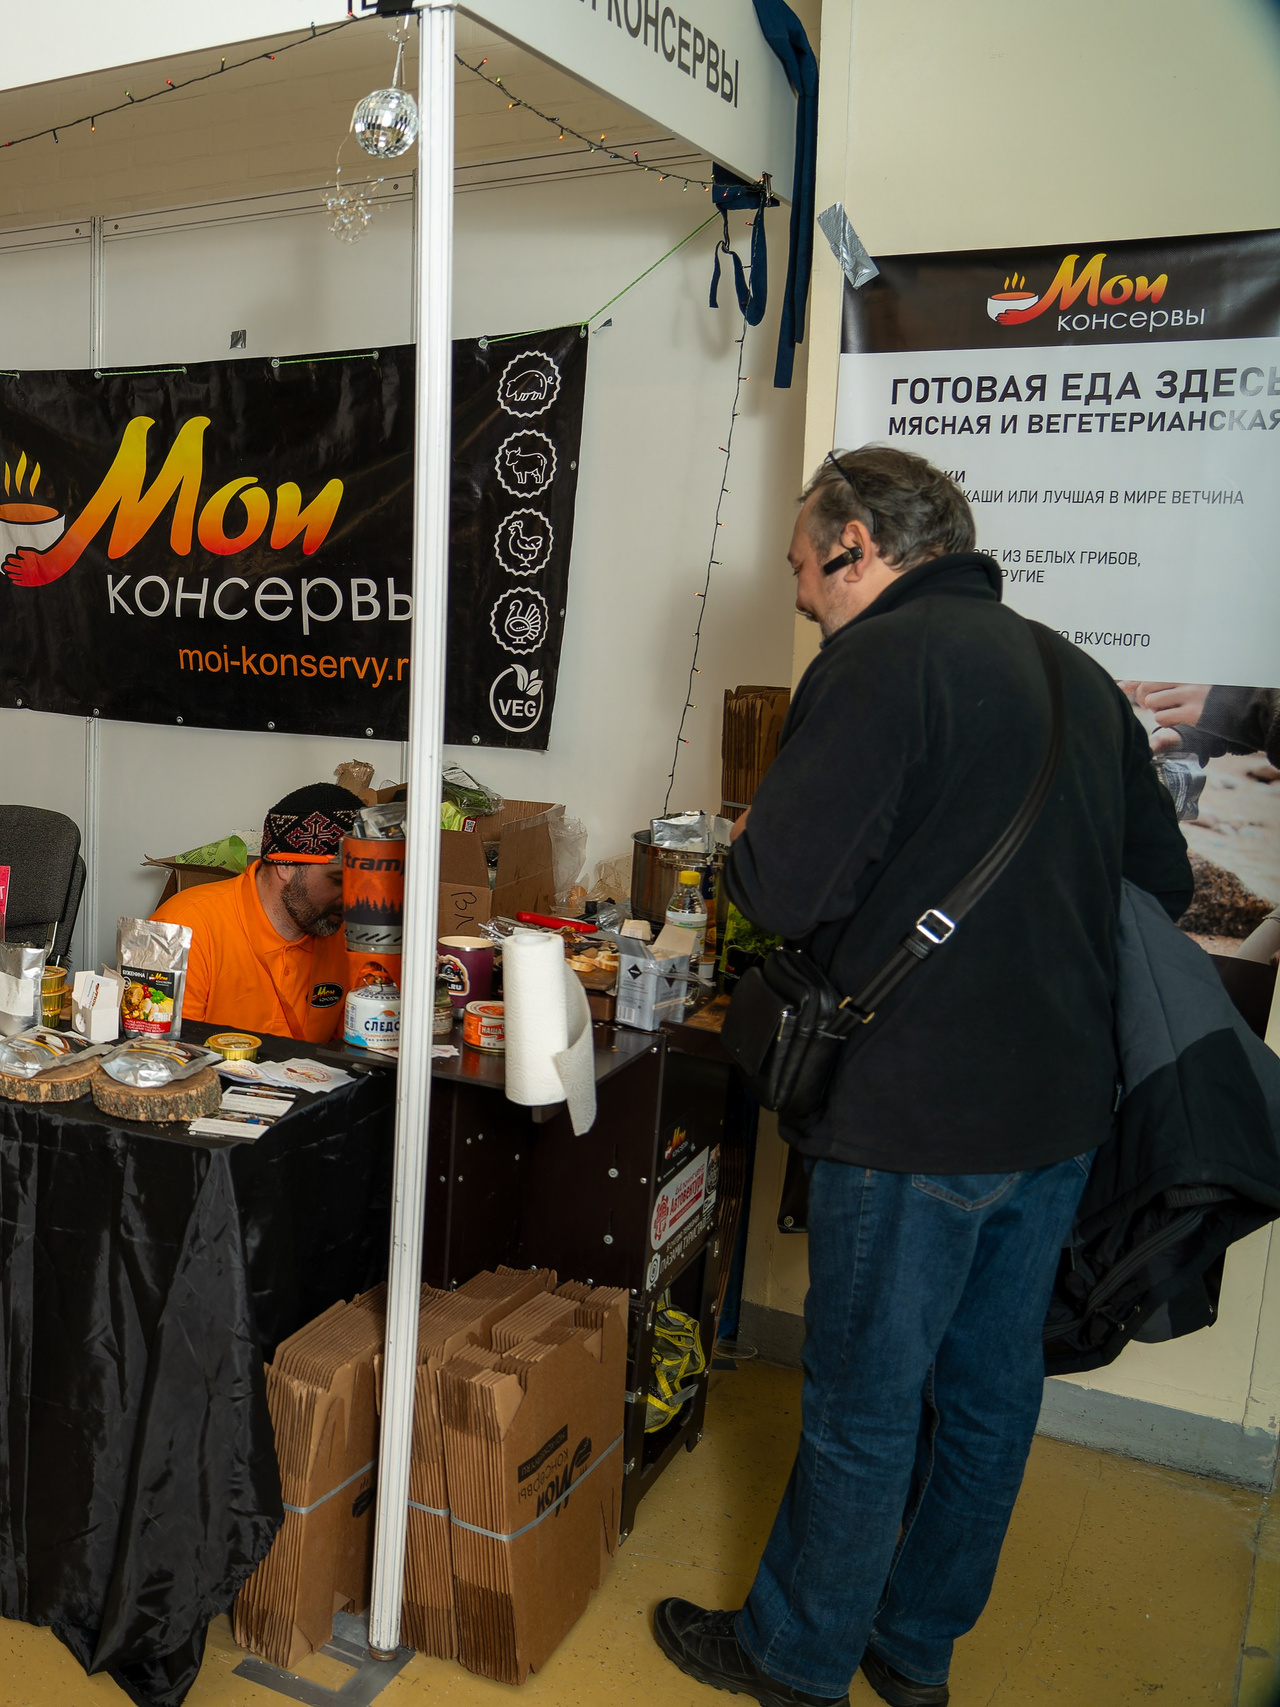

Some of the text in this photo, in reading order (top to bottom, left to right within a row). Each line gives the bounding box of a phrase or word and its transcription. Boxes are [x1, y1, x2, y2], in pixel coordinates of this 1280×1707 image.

[1042, 253, 1169, 310] Мои
[1057, 308, 1205, 332] консервы
[892, 374, 1047, 405] ГОТОВАЯ
[1061, 371, 1141, 406] ЕДА
[889, 409, 1280, 436] МЯСНАЯ И ВЕГЕТЕРИАНСКАЯ
[63, 415, 344, 560] Мои
[1008, 490, 1038, 503] ИЛИ
[1042, 490, 1105, 504] ЛУЧШАЯ
[1109, 490, 1119, 504] В
[1124, 490, 1166, 504] МИРЕ
[1171, 490, 1244, 505] ВЕТЧИНА
[1002, 549, 1021, 563] ИЗ
[1025, 550, 1076, 564] БЕЛЫХ
[1080, 551, 1141, 567] ГРИБОВ,
[1001, 569, 1045, 583] РУГИЕ
[1074, 631, 1150, 647] ВКУСНОГО
[180, 644, 409, 688] moi-konservy.r
[498, 698, 537, 719] VEG
